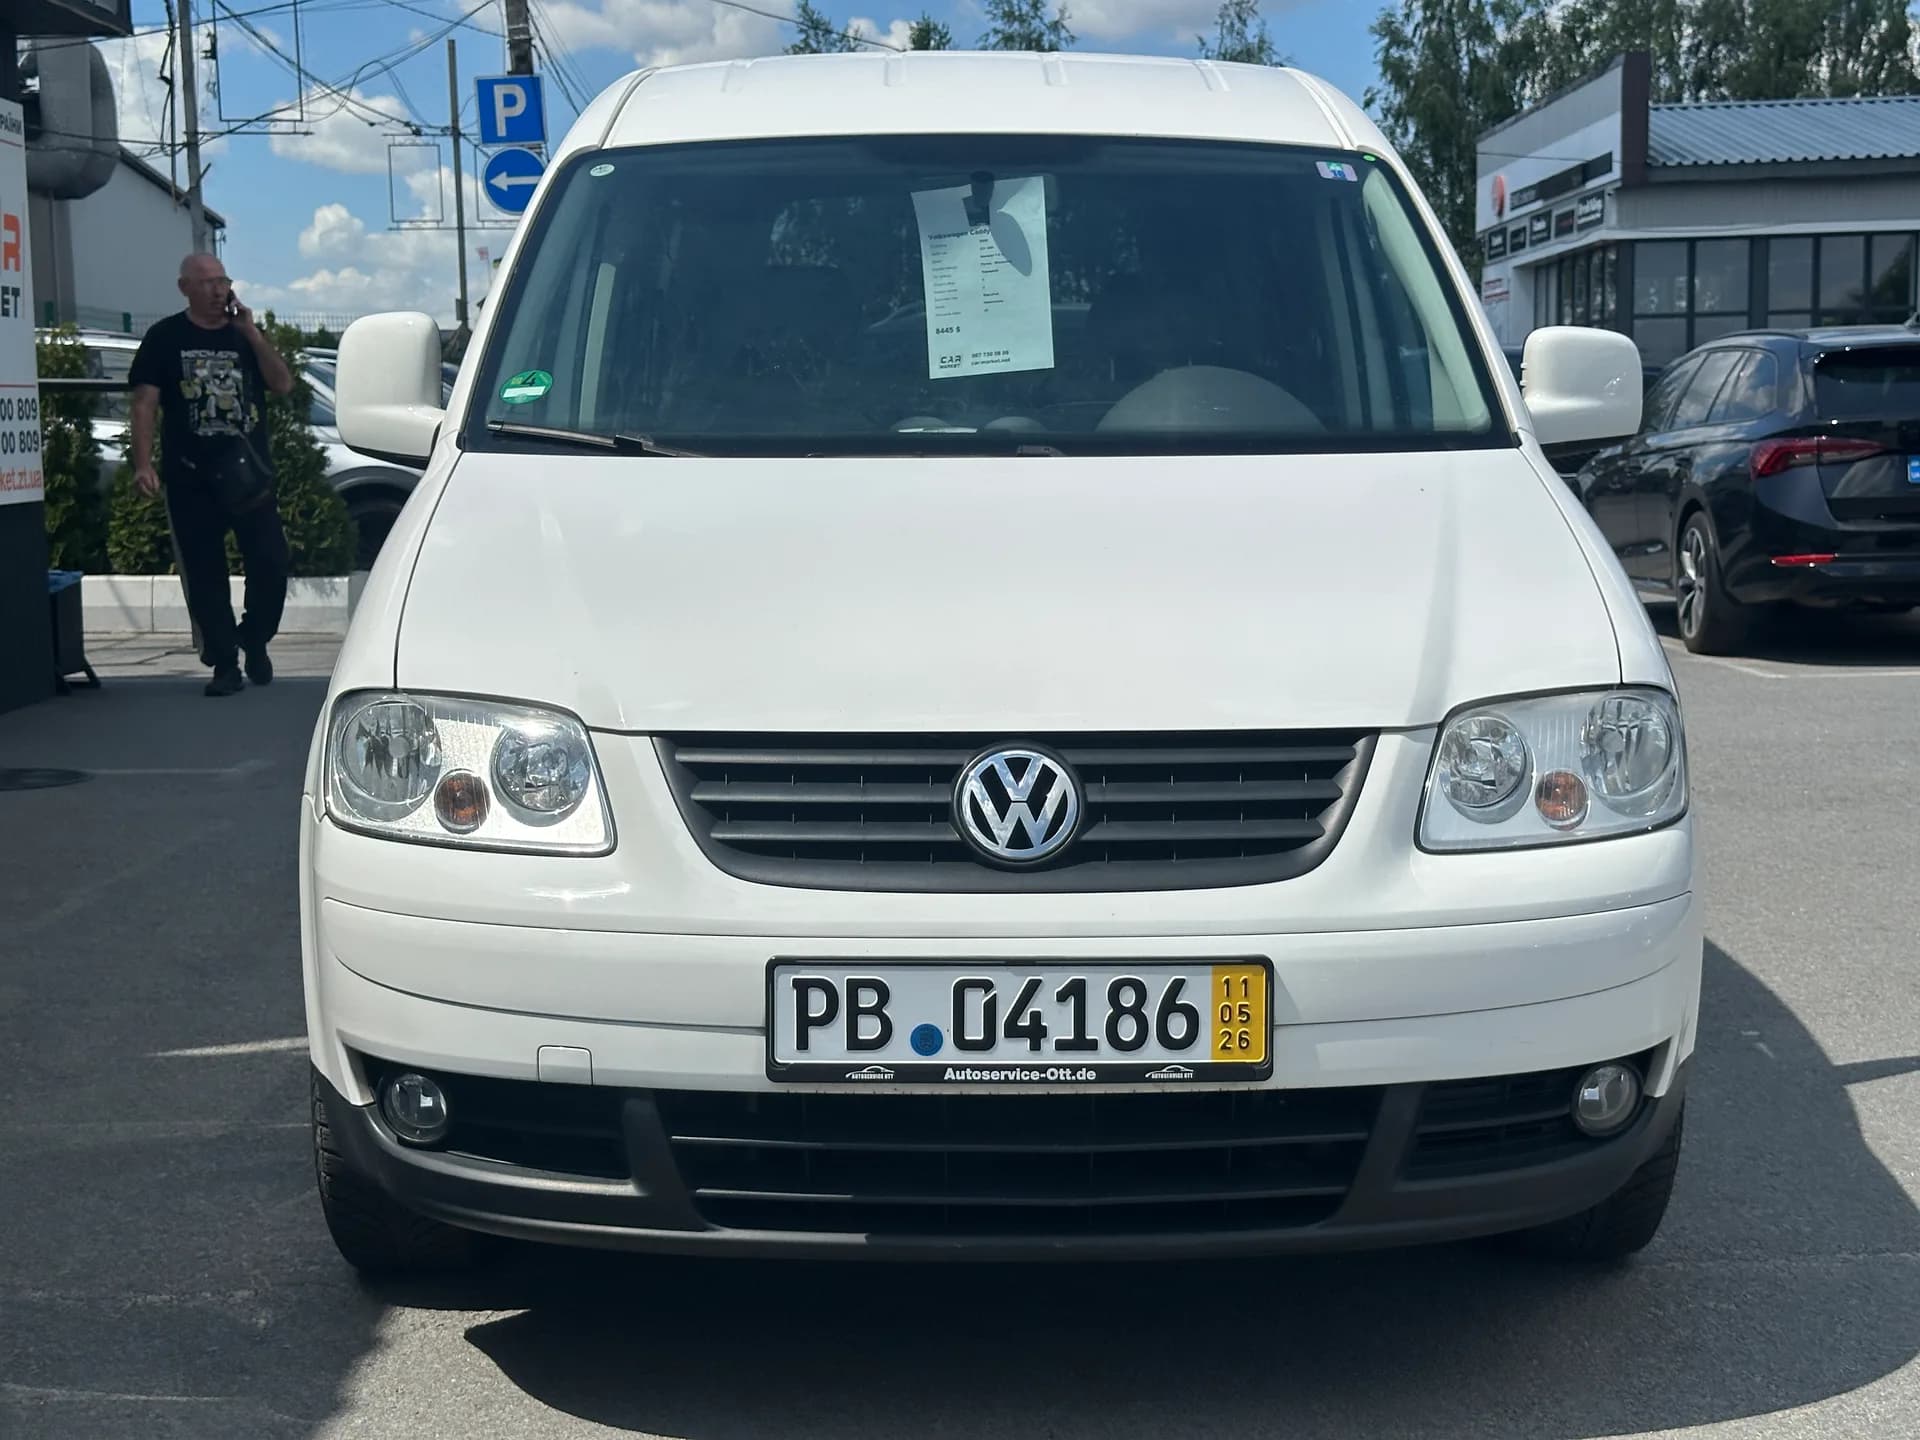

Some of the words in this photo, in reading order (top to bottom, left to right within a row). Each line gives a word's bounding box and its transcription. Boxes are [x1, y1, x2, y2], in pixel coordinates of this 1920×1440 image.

[494, 84, 528, 137] P
[3, 213, 21, 272] R
[1, 285, 21, 318] ET
[935, 327, 954, 335] 8445
[940, 355, 962, 364] CAR
[520, 371, 537, 386] 4
[0, 398, 14, 421] 00
[17, 397, 38, 421] 809
[1, 431, 16, 455] 00
[19, 430, 40, 454] 809
[962, 750, 1077, 859] VW
[1221, 977, 1249, 998] 11
[791, 976, 893, 1052] PB
[951, 976, 1201, 1052] 04186
[1219, 1003, 1251, 1023] 05
[1219, 1029, 1250, 1050] 26
[944, 1067, 1097, 1082] Autoservice-Ott.de
